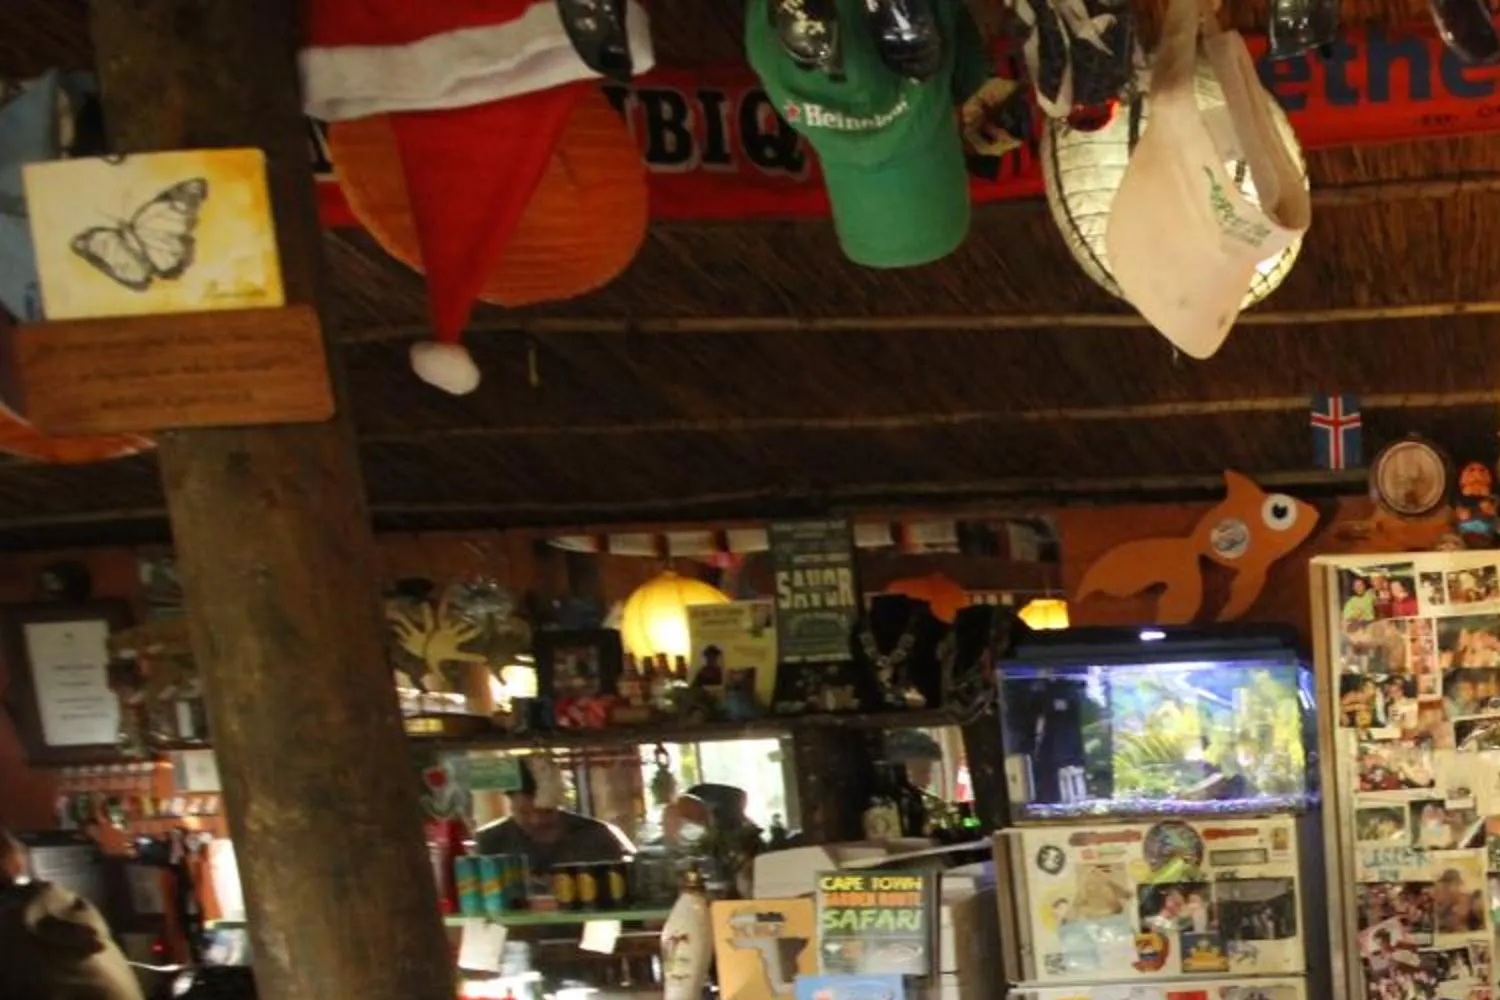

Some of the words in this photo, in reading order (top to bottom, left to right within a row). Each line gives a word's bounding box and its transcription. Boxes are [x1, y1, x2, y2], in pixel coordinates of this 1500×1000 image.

[820, 875, 863, 891] CAPE
[871, 875, 923, 891] TOWN
[822, 909, 923, 932] SAFARI
